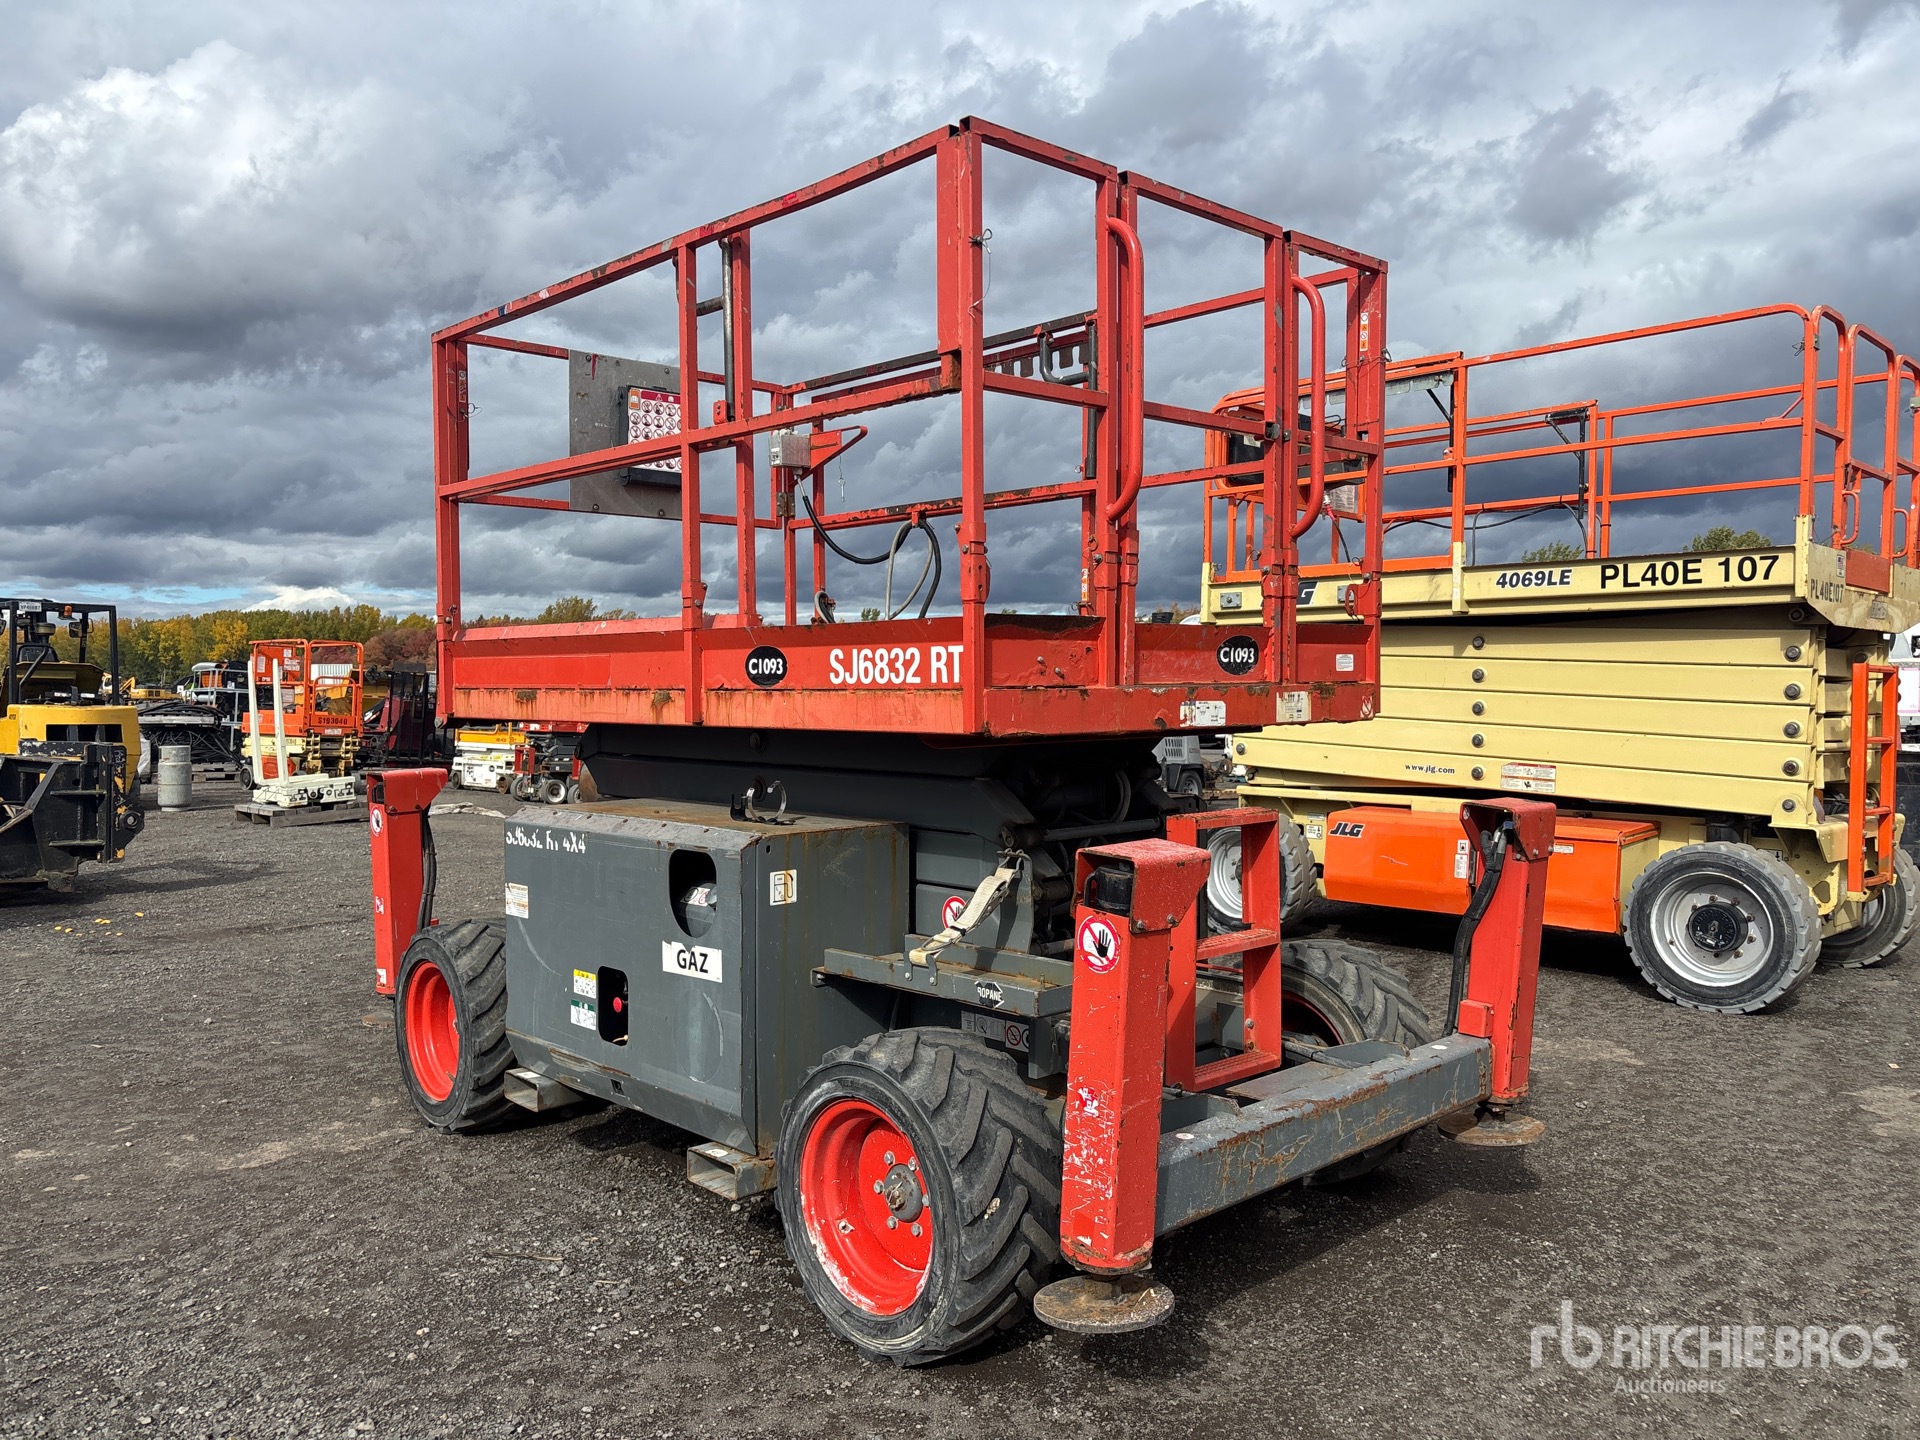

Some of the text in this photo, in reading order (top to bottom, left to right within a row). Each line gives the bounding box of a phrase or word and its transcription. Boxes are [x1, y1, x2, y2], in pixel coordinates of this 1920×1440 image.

[1496, 568, 1572, 589] 4069LE
[1600, 555, 1779, 589] PL40E 107
[1220, 647, 1255, 663] C1093
[749, 658, 783, 675] C1093
[829, 645, 964, 685] SJ6832 RT
[1405, 764, 1455, 775] www.jlg.com
[1329, 821, 1365, 838] JLG
[676, 949, 709, 974] GAZ
